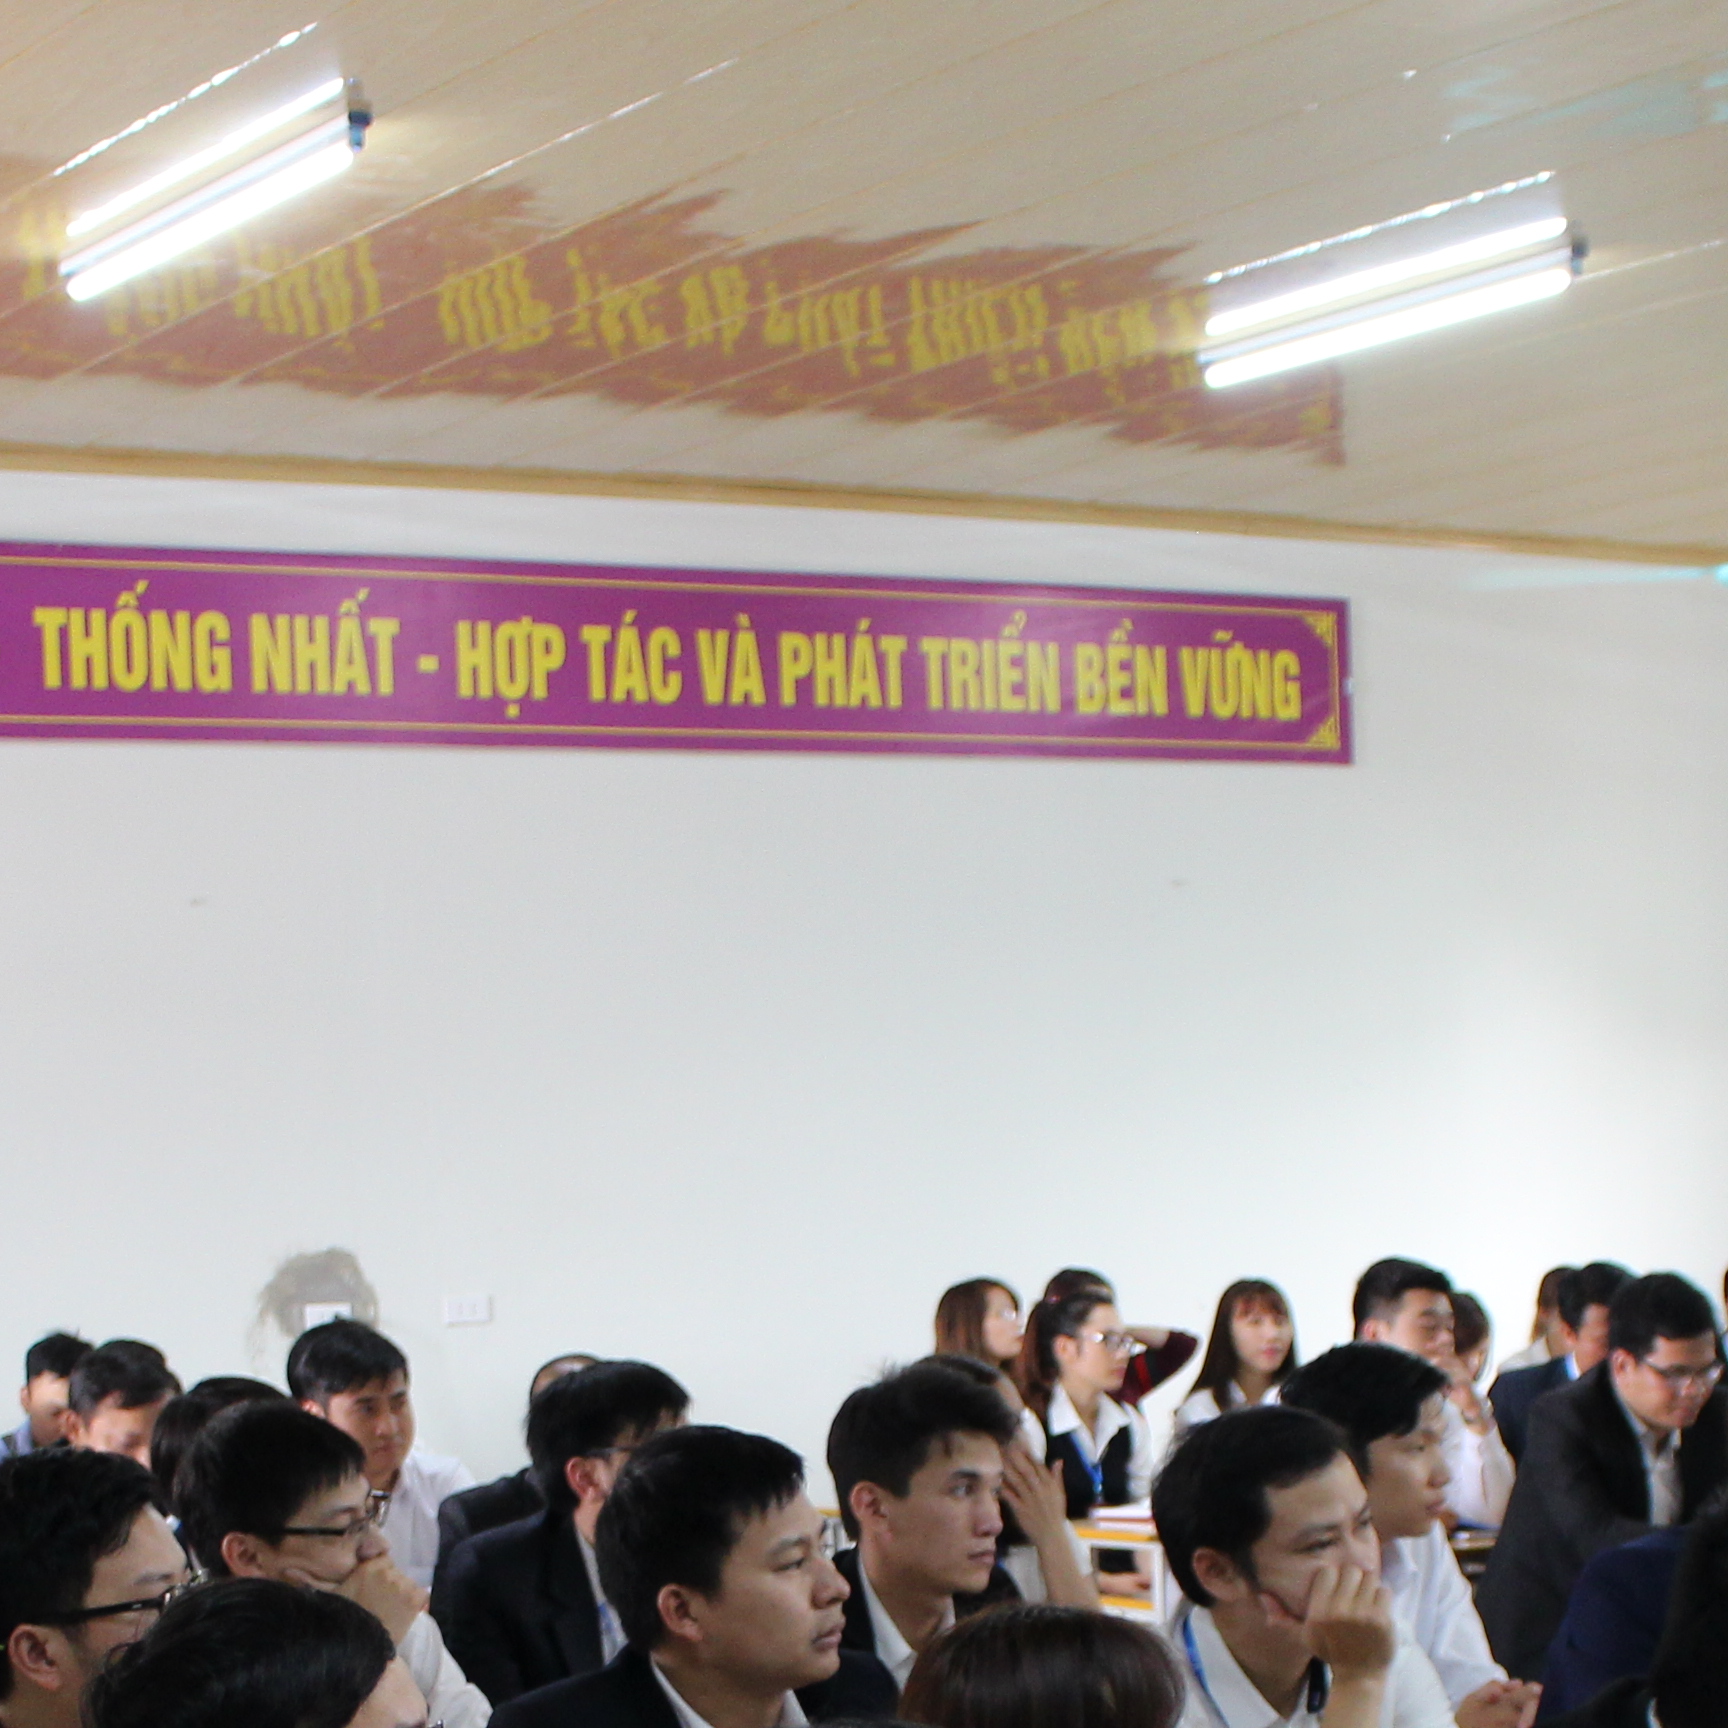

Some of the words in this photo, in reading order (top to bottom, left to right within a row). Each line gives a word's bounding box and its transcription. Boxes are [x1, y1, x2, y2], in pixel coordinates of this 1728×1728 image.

[32, 579, 233, 693] THỐNG
[250, 587, 400, 696] NHẤT
[456, 616, 567, 718] HỢP
[580, 610, 683, 705] TÁC
[696, 614, 766, 706] VÀ
[779, 617, 908, 709] PHÁT
[920, 609, 1061, 713] TRIỂN
[1178, 629, 1302, 721] VỮNG
